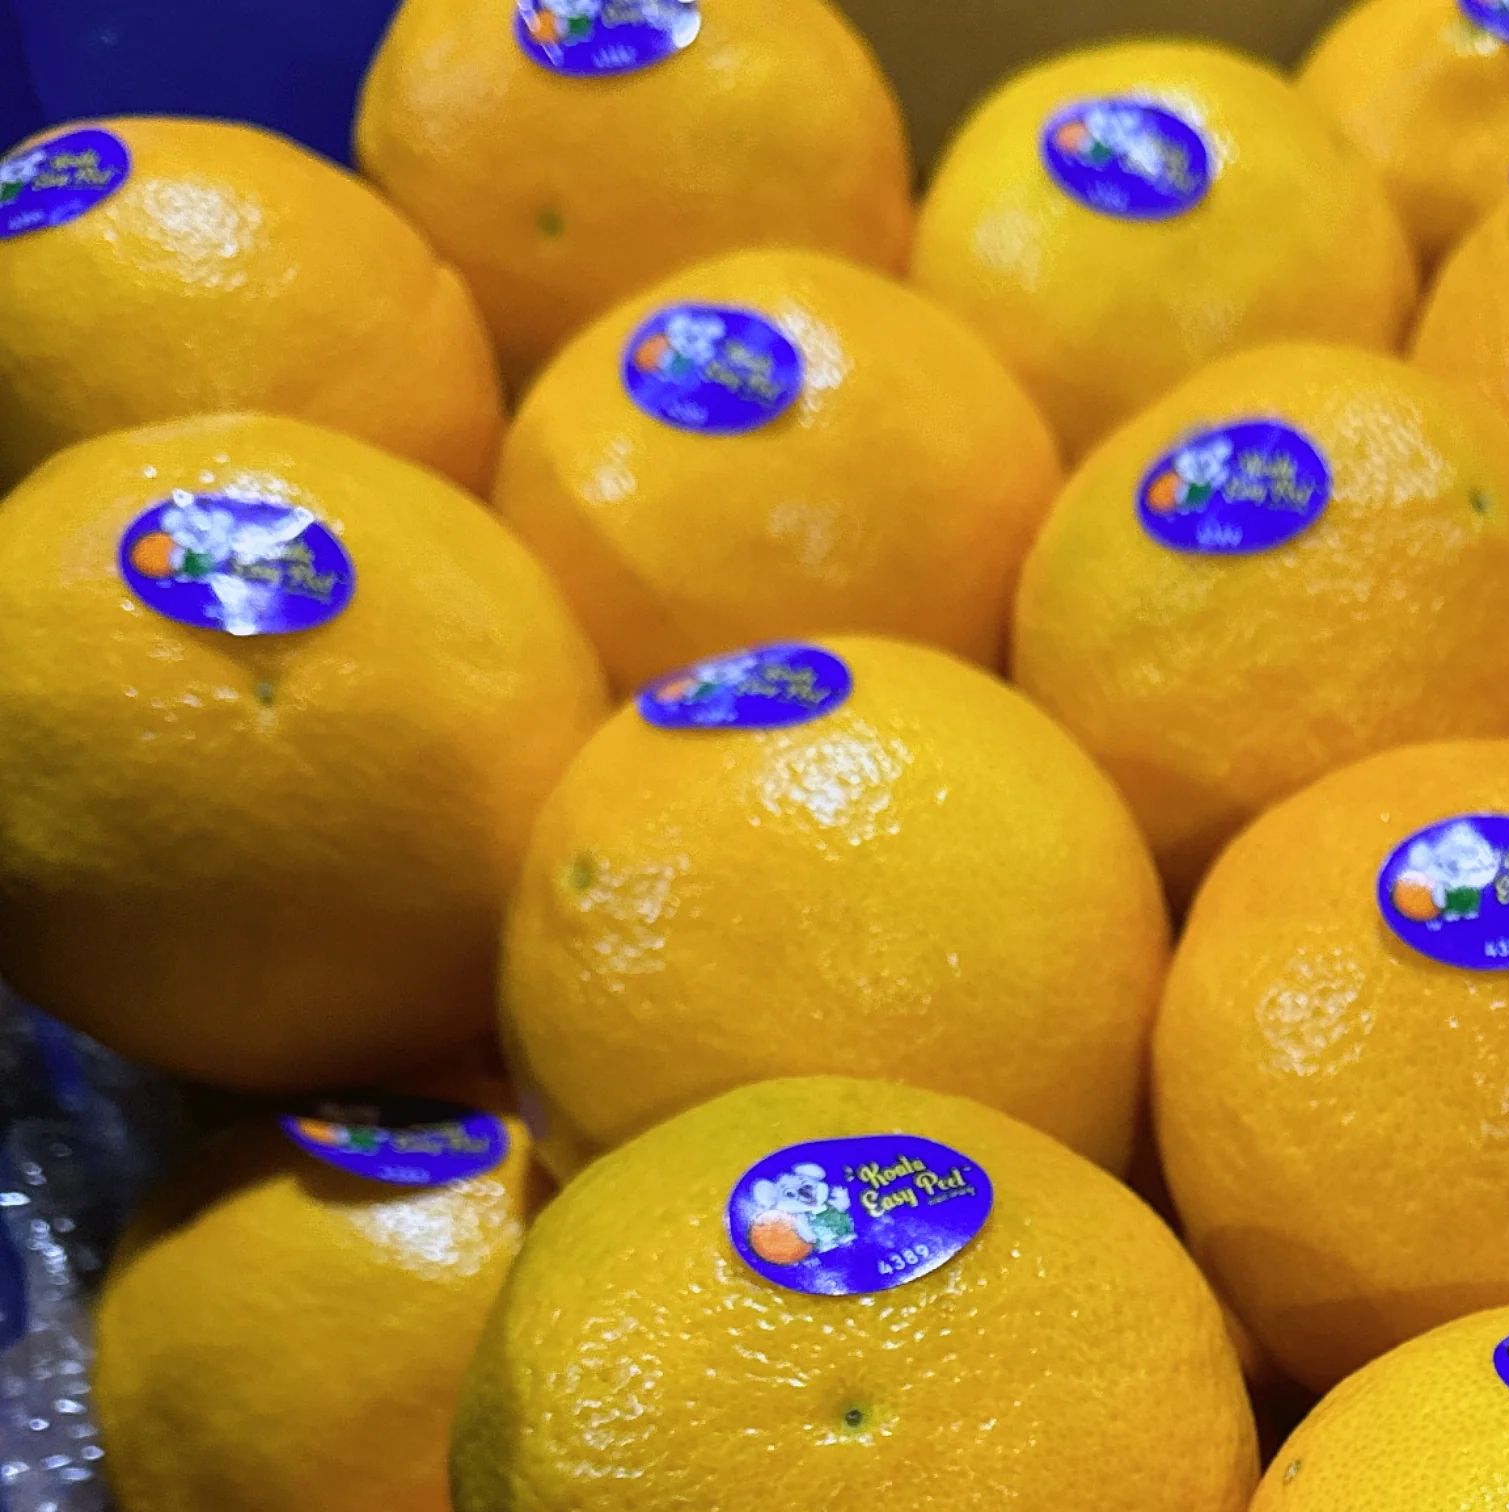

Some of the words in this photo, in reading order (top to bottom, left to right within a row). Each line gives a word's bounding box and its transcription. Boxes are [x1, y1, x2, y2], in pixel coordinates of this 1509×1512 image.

[857, 1155, 926, 1189] Koala
[860, 1187, 918, 1217] Easy
[915, 1168, 966, 1195] Peel
[877, 1245, 930, 1276] 4389
